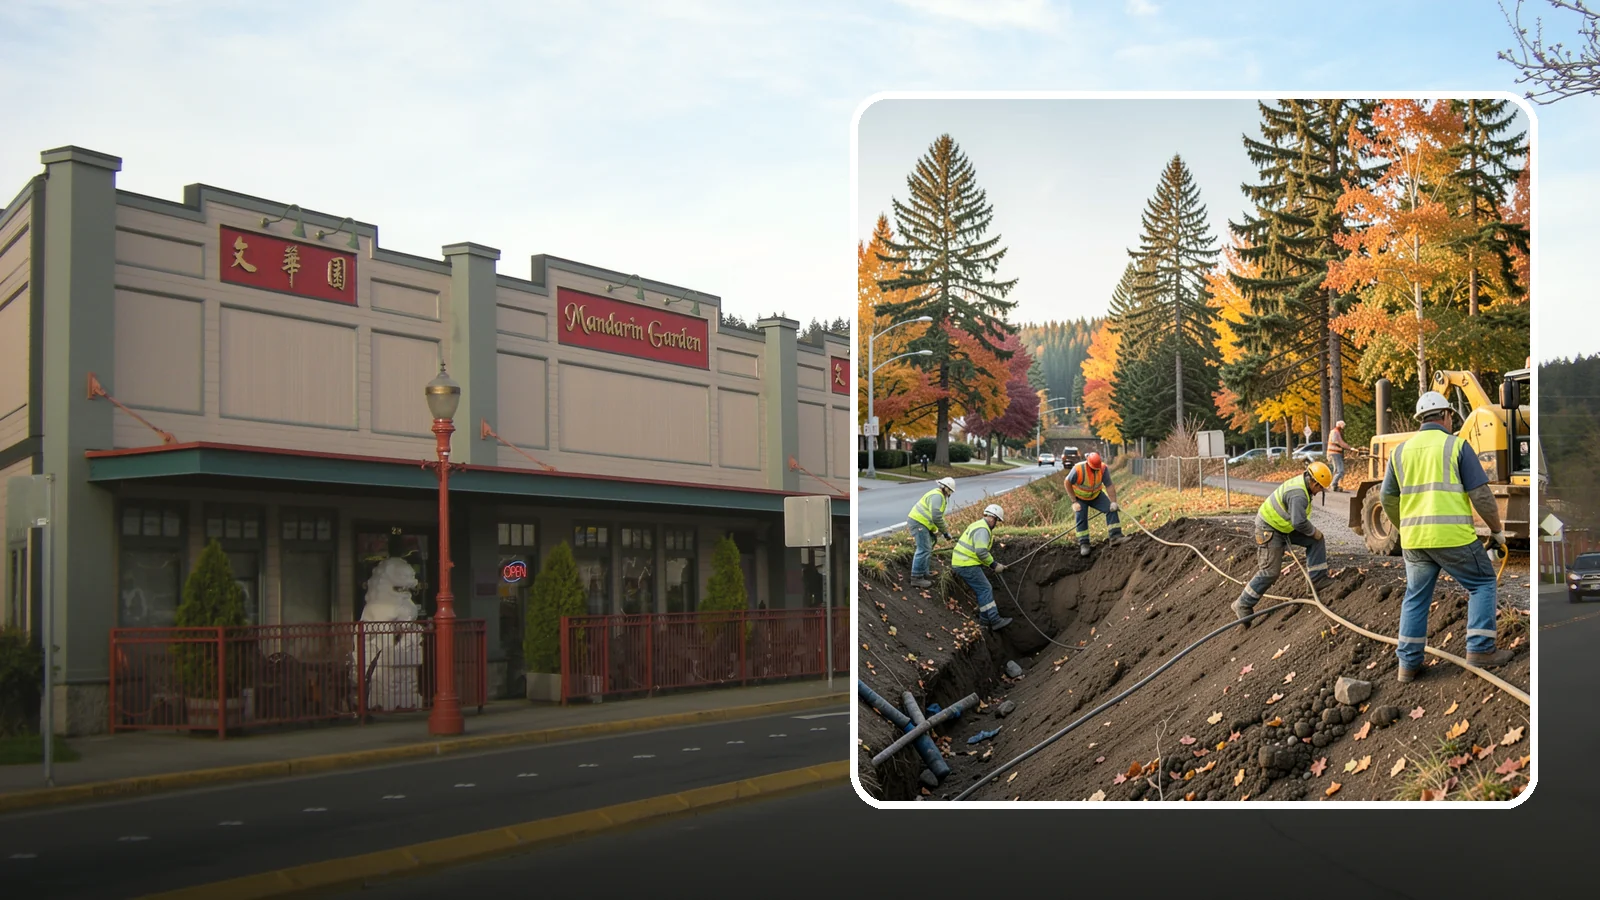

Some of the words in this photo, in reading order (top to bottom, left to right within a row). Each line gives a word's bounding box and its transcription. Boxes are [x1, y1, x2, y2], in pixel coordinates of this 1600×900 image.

[231, 236, 346, 290] 文華園
[564, 302, 644, 341] Mandarin
[648, 320, 702, 352] Garden
[503, 565, 527, 578] OPEN
